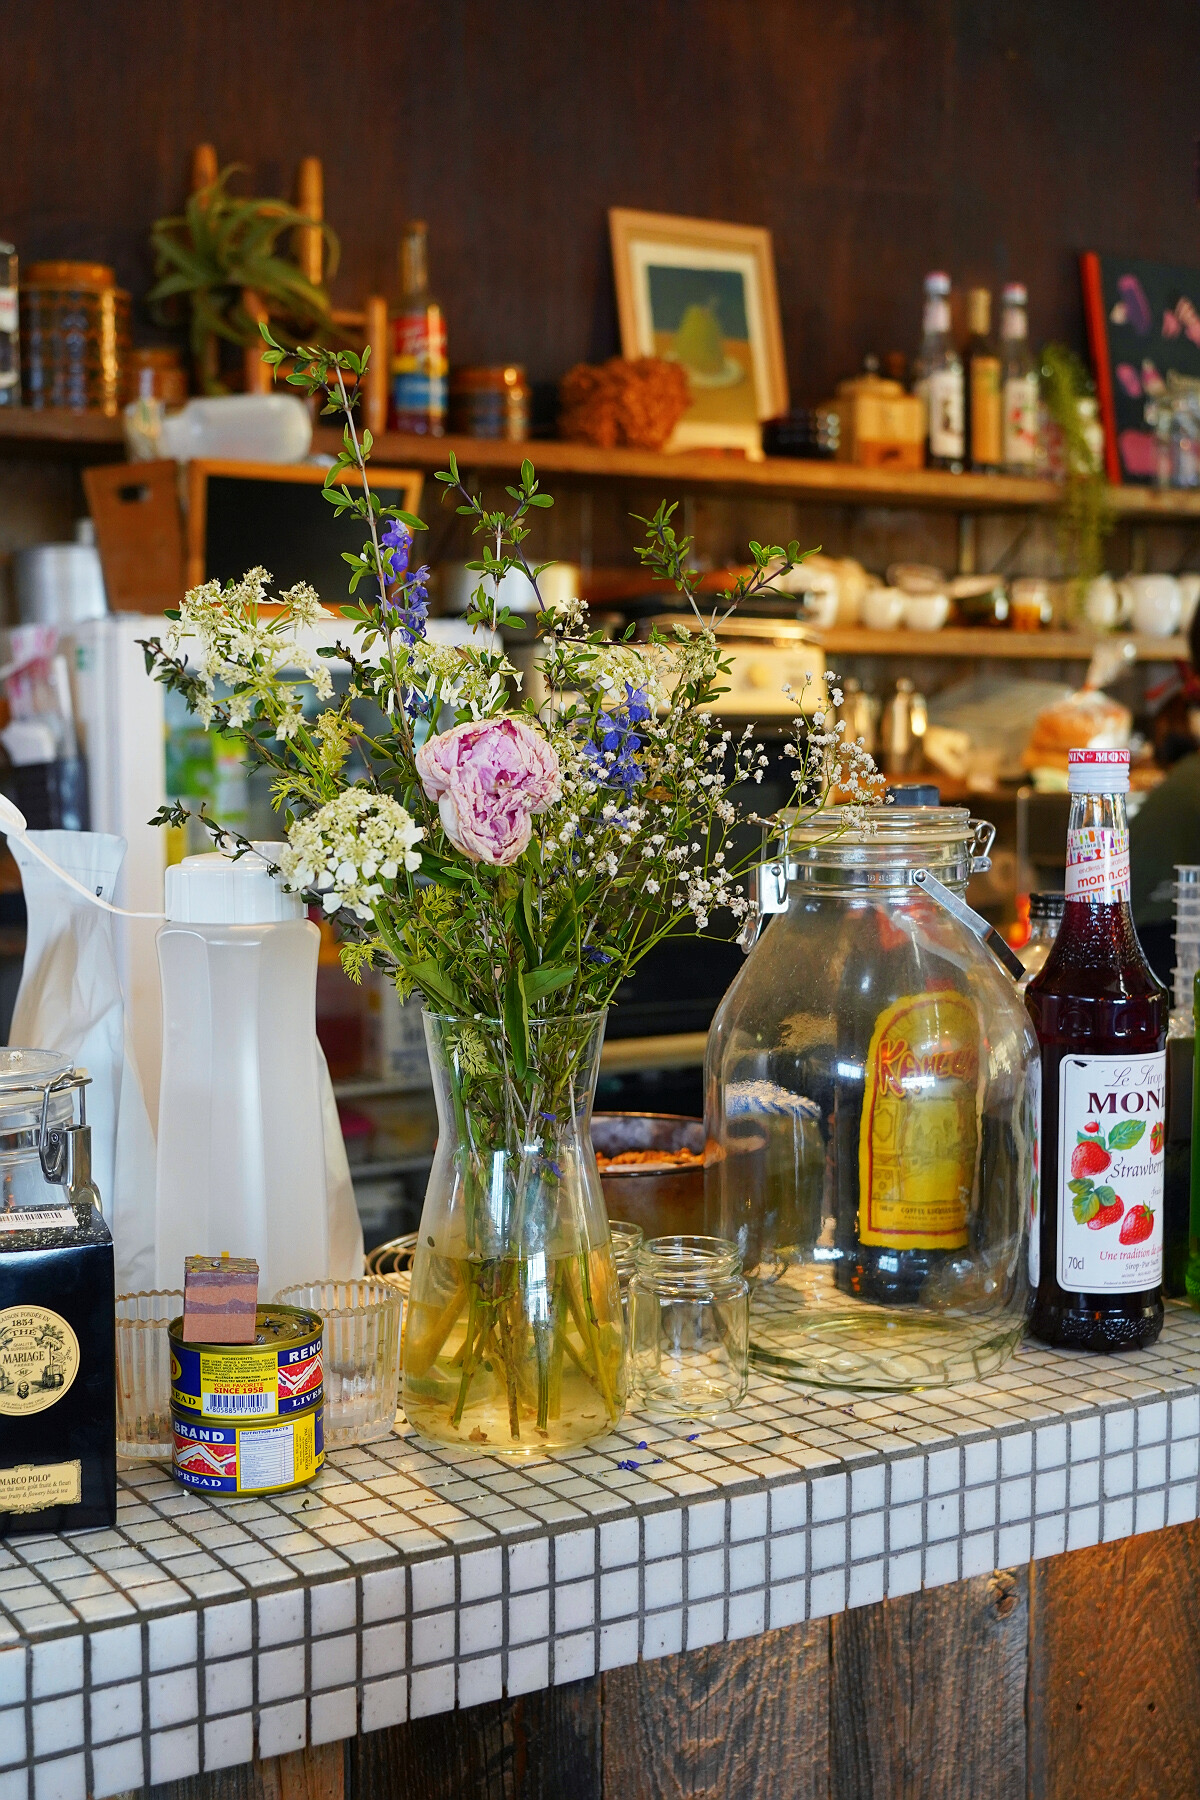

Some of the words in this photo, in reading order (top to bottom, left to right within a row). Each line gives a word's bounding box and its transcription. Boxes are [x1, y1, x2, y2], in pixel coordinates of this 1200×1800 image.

[1077, 864, 1131, 888] monn.co
[1104, 1066, 1132, 1087] Le
[1134, 1064, 1163, 1088] Sirop
[1100, 1251, 1117, 1260] Une
[1119, 1247, 1150, 1260] tradition
[1068, 1256, 1084, 1270] 70cl
[0, 1312, 19, 1324] AISON
[12, 1318, 34, 1326] 1854
[2, 1350, 45, 1364] MARIAGE
[289, 1340, 322, 1363] RENO
[174, 1420, 225, 1442] BRAND
[0, 1477, 26, 1485] MARCO
